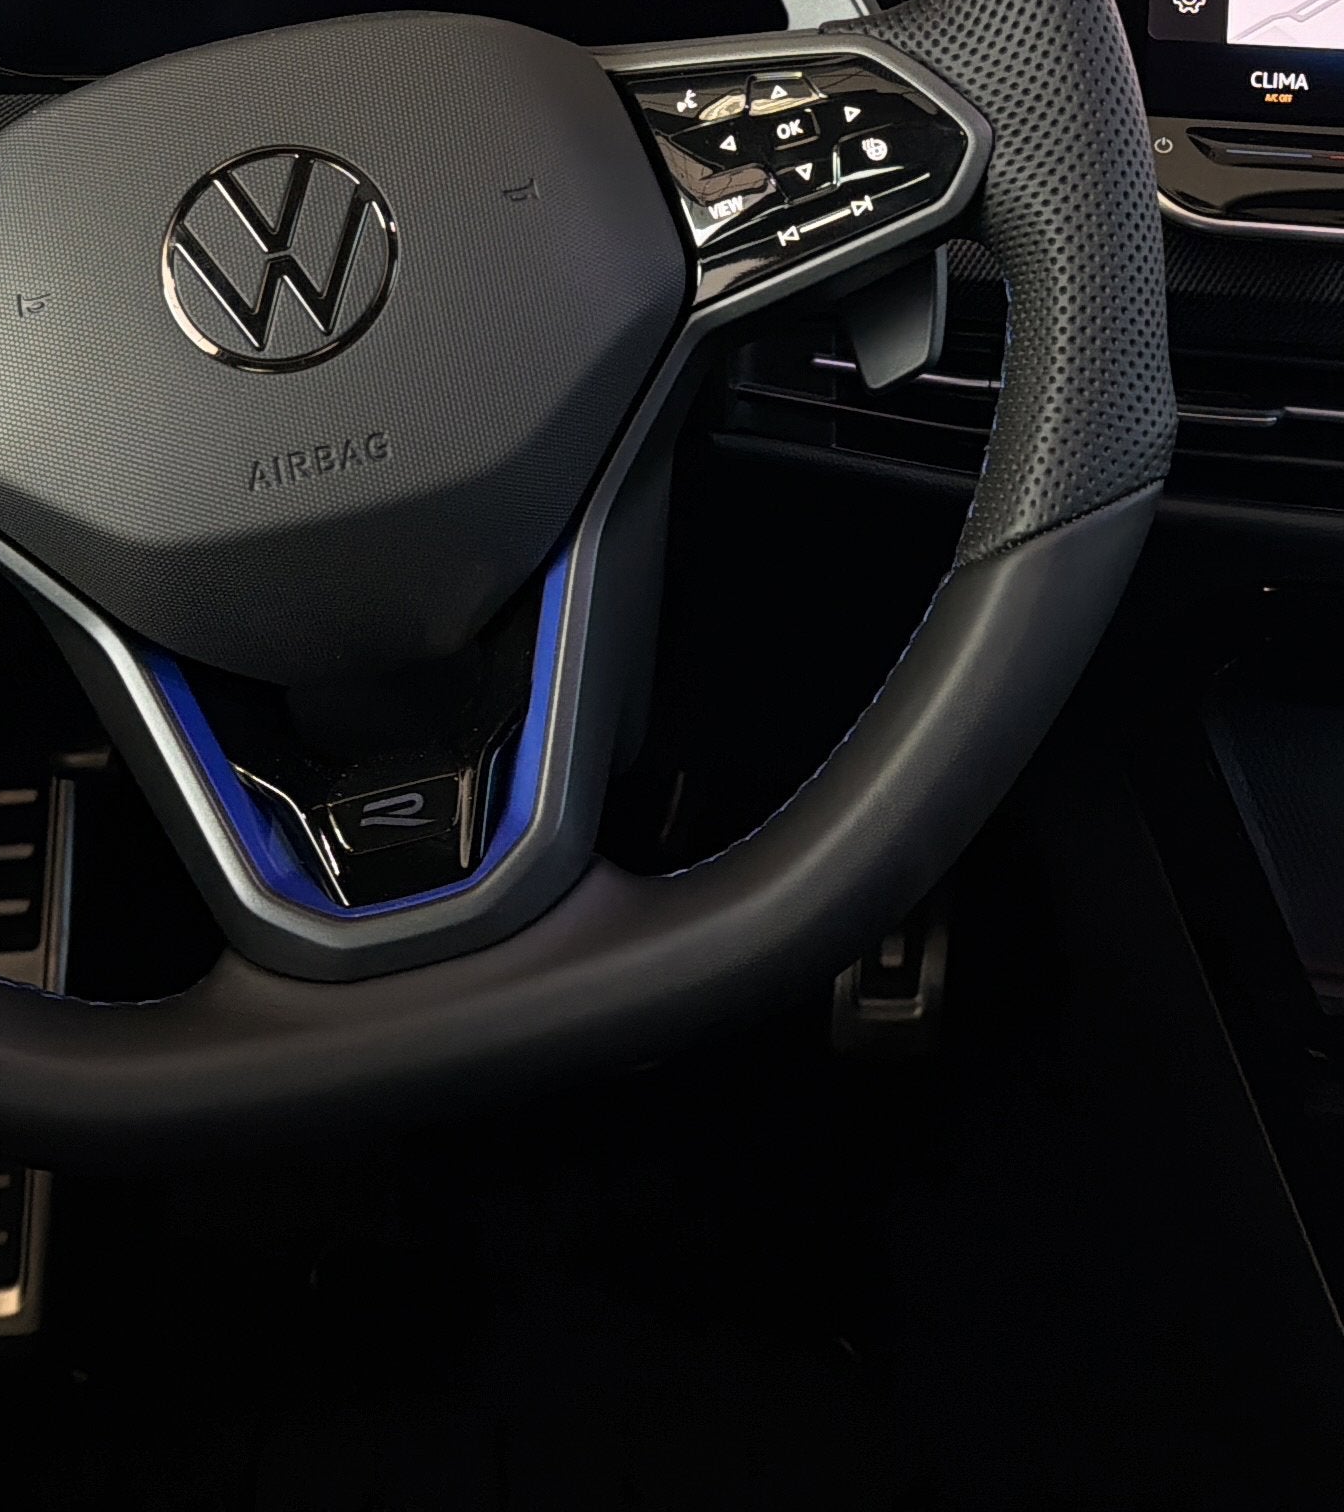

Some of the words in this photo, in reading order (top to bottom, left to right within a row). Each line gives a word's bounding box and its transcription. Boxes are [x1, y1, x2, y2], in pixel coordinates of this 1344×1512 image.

[1250, 71, 1309, 91] CLIMA
[776, 118, 804, 139] OK
[708, 195, 745, 219] VIEW
[249, 431, 394, 491] AIRBAG
